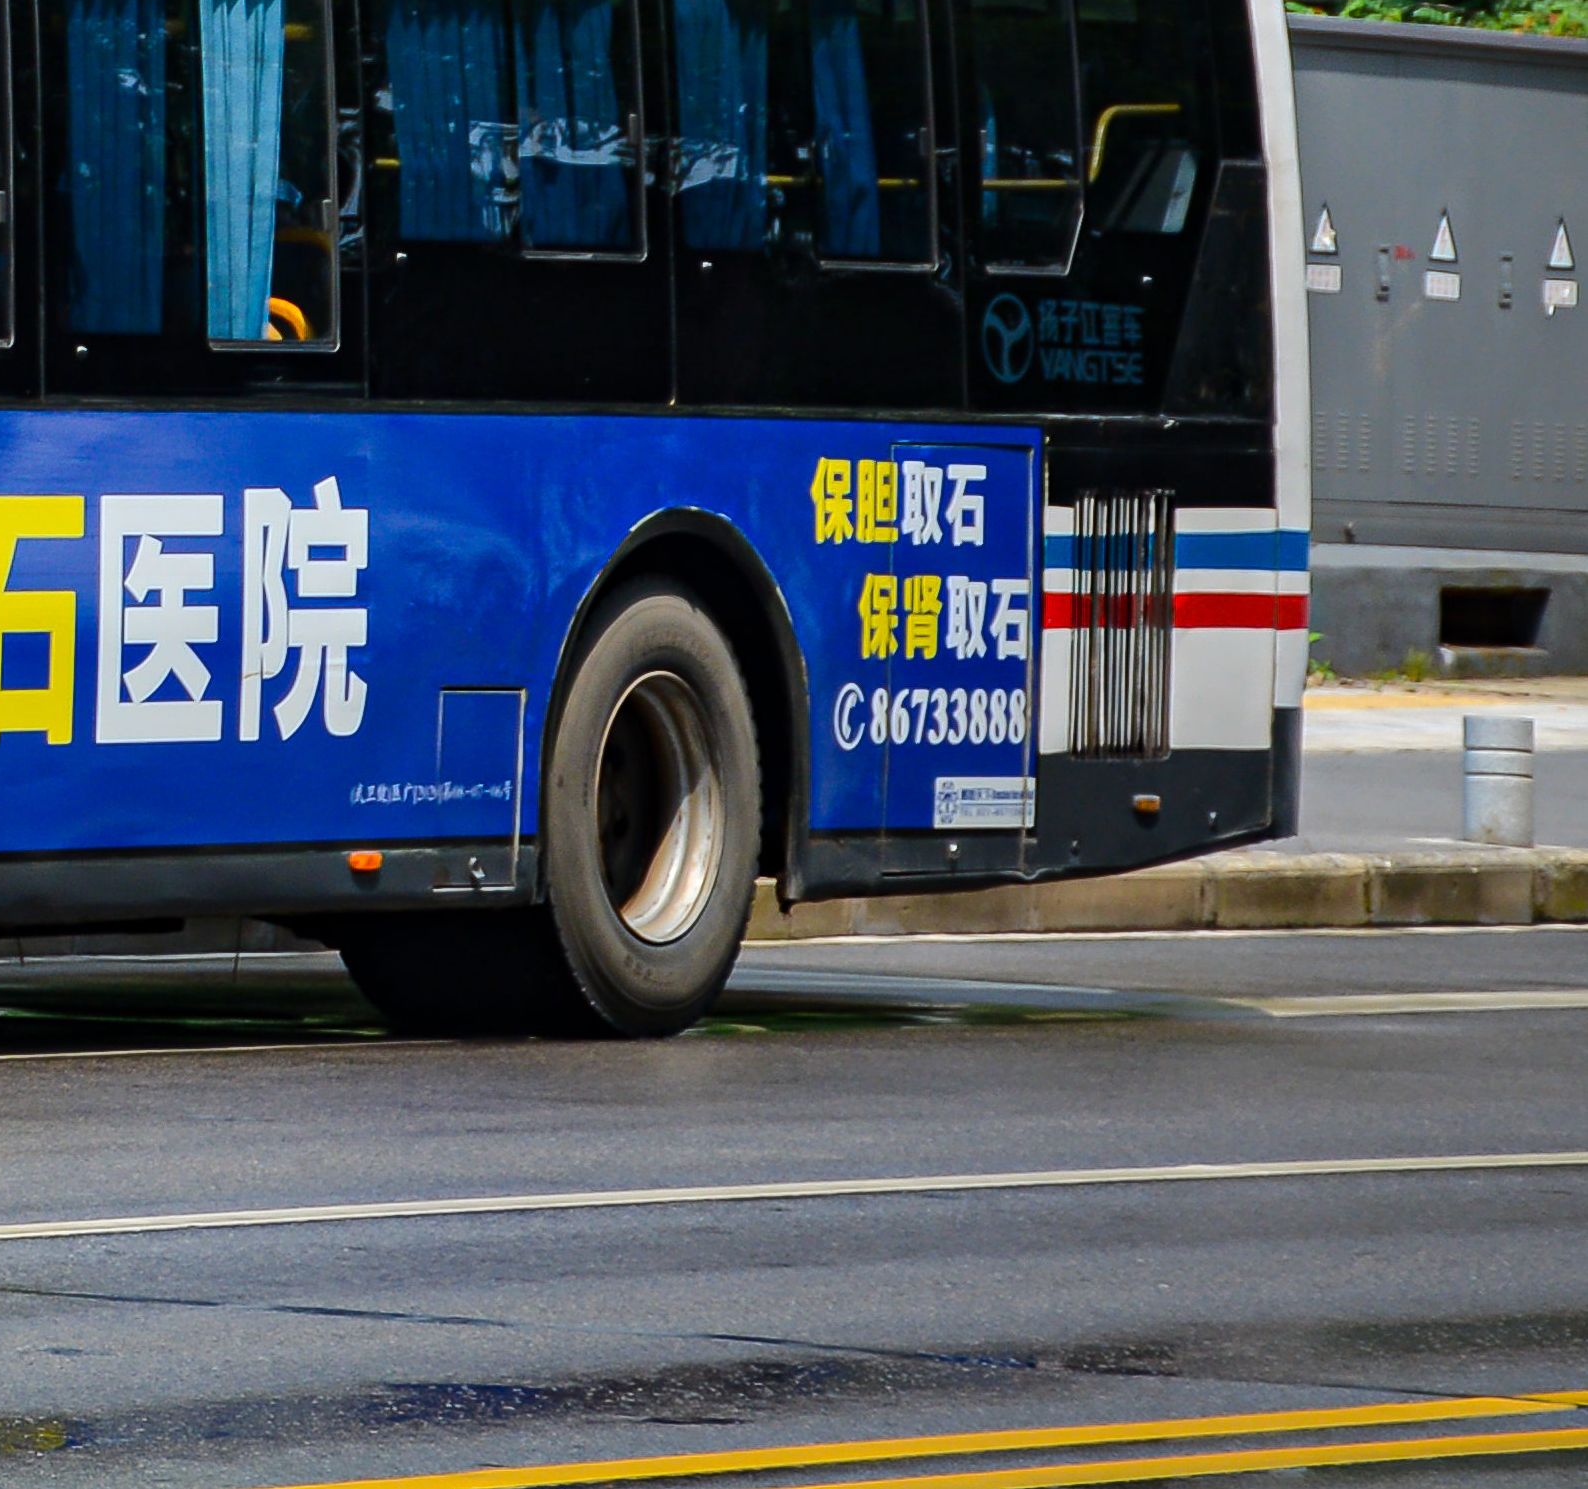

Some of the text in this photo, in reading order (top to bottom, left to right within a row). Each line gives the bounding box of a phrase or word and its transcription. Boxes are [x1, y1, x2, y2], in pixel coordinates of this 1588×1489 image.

[810, 457, 987, 546] 保胆取石
[858, 573, 1031, 661] 保肾取石
[869, 687, 1027, 745] 86733888
